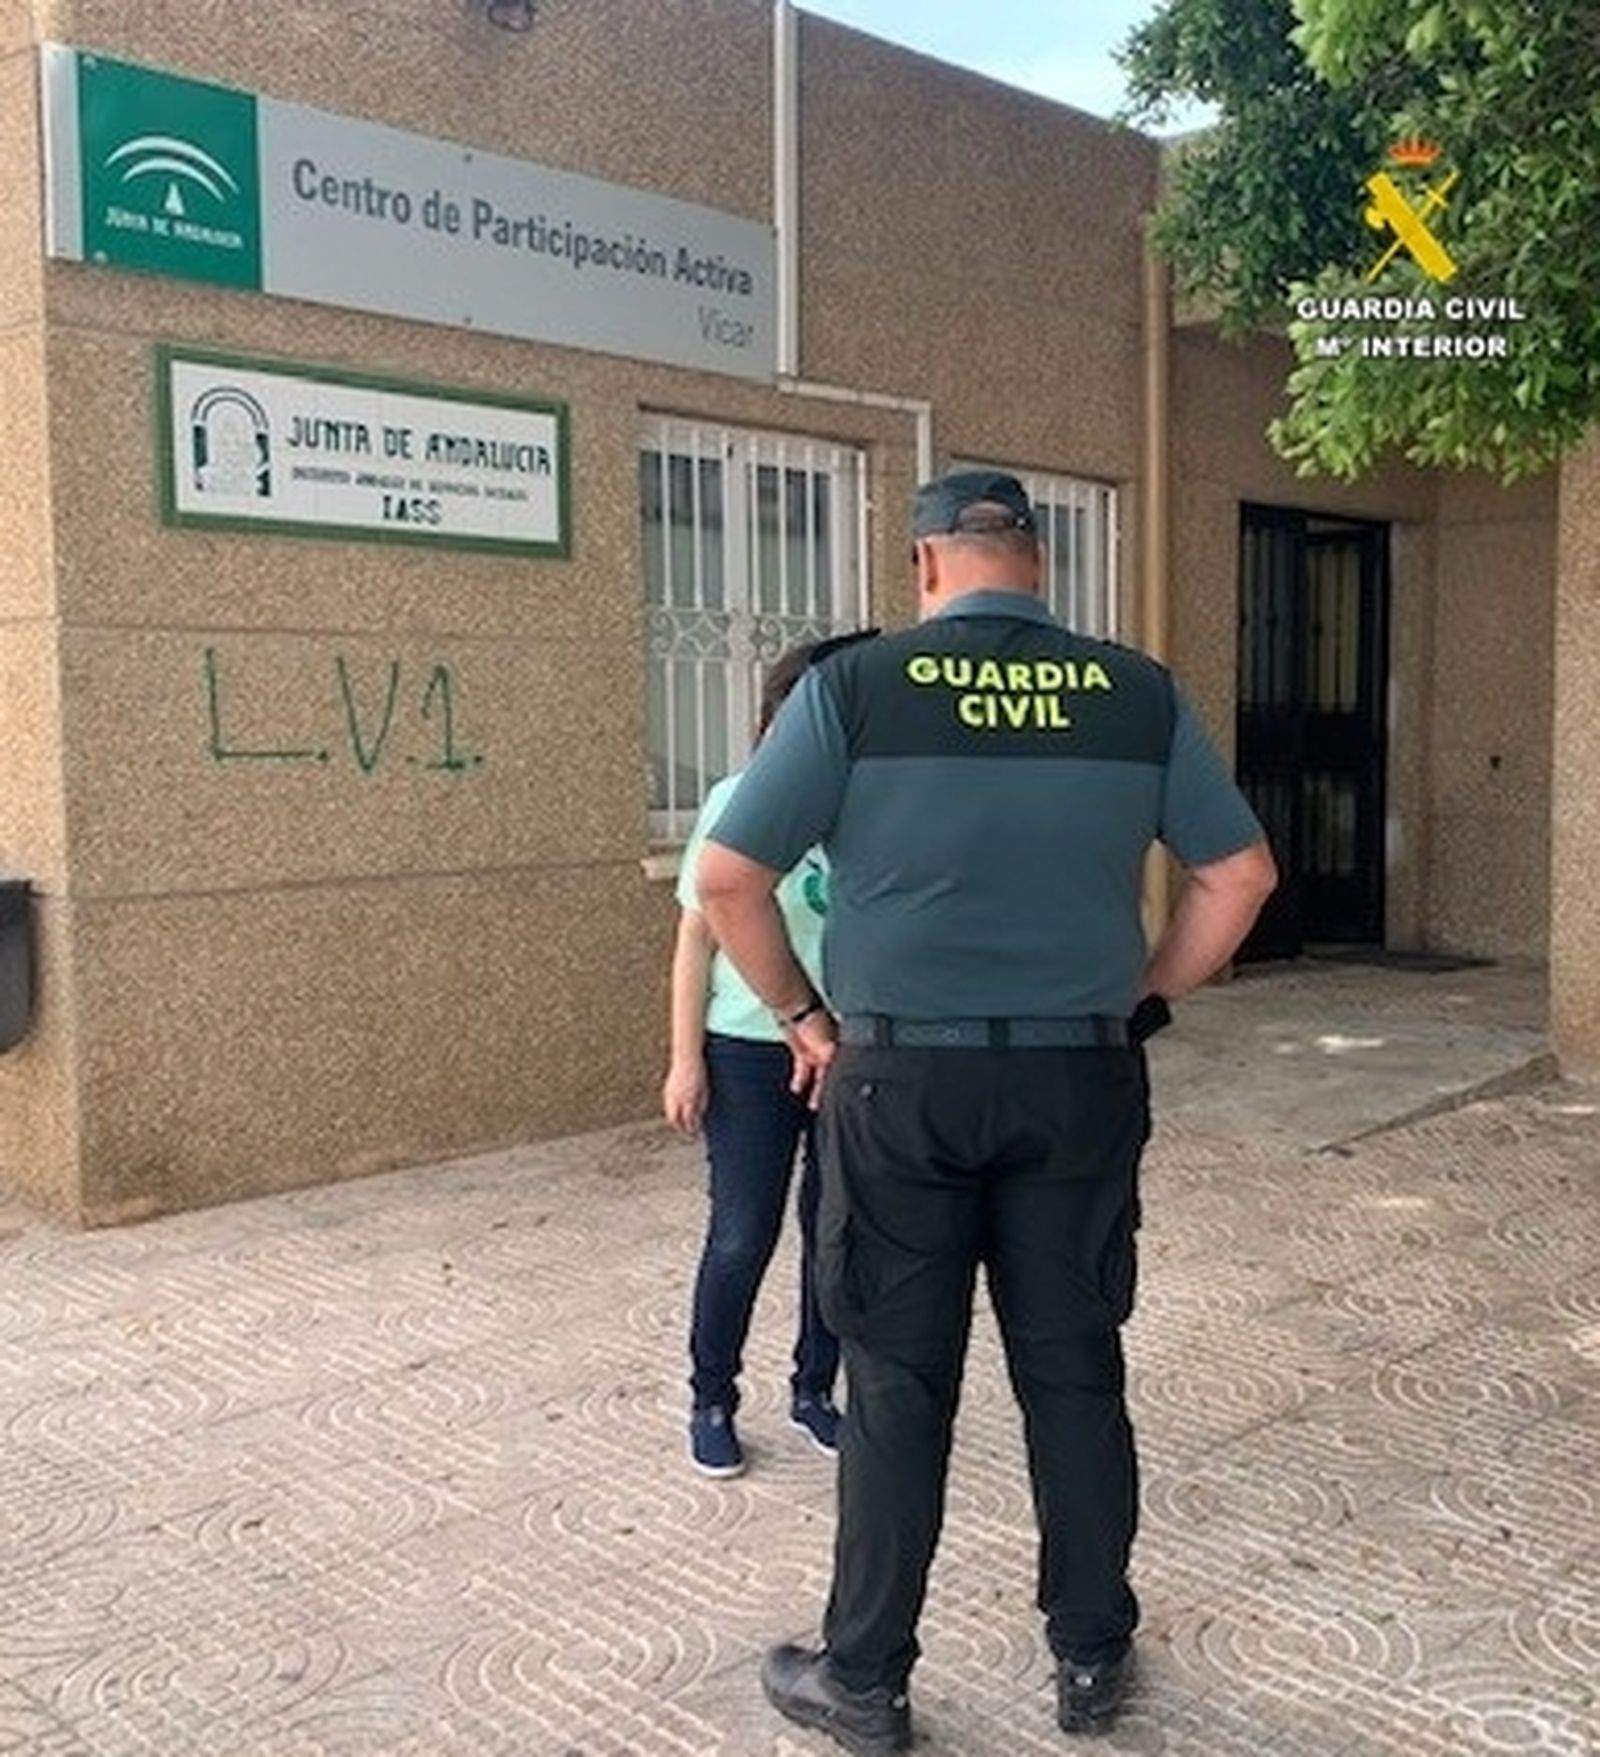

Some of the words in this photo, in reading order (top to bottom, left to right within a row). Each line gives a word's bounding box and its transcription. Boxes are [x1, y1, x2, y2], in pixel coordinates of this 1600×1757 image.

[292, 157, 412, 225] Centro
[422, 189, 461, 236] de
[472, 198, 668, 279] Participación
[673, 247, 753, 295] Activa
[286, 416, 372, 454] JUNTA
[383, 425, 413, 459] DE
[383, 494, 442, 526] IASS
[907, 655, 1113, 692] GUARDIA
[958, 693, 1071, 729] CIVIL
